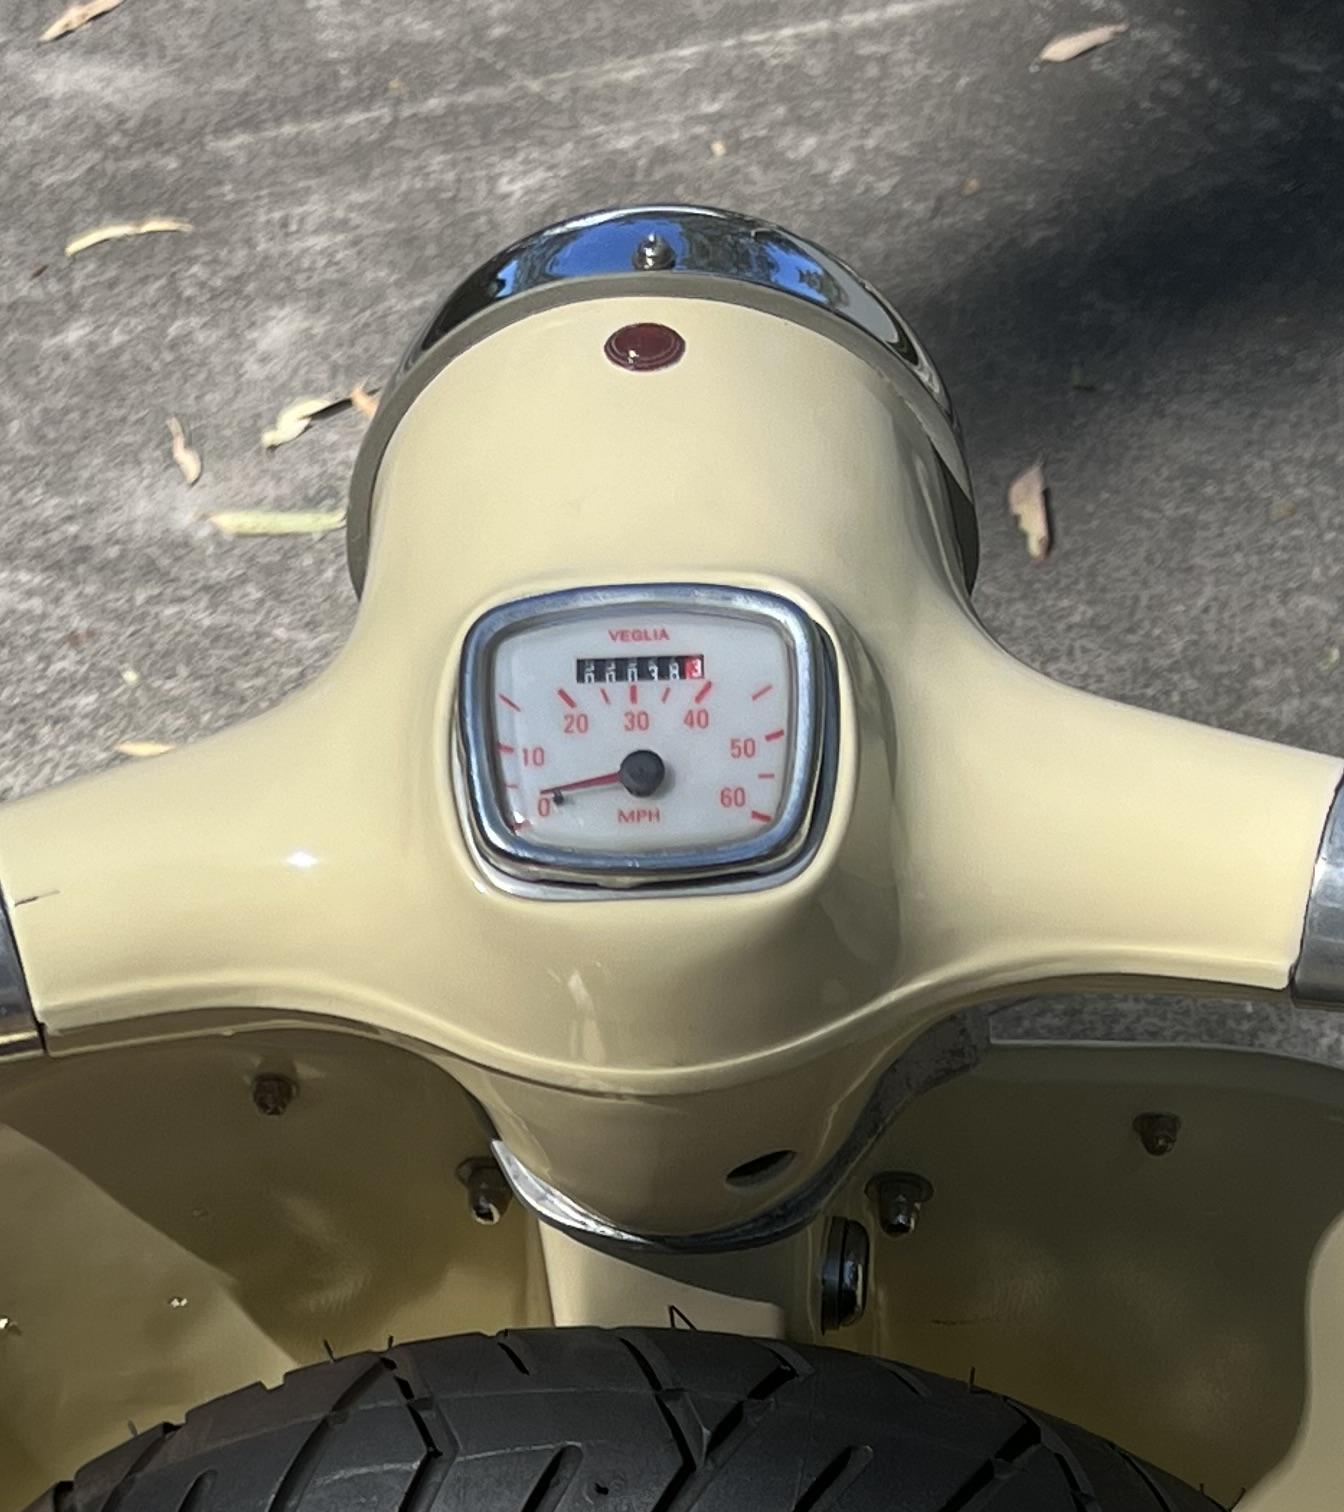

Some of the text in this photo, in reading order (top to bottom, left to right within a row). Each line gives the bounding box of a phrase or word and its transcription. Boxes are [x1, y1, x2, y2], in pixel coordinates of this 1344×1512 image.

[608, 628, 671, 642] VEGLIA
[563, 714, 589, 734] 20
[623, 711, 649, 731] 30
[683, 709, 709, 729] 40
[522, 747, 545, 767] 10
[730, 738, 755, 759] 50
[537, 797, 550, 817] 0
[720, 787, 745, 808] 60
[617, 808, 661, 823] MPH
